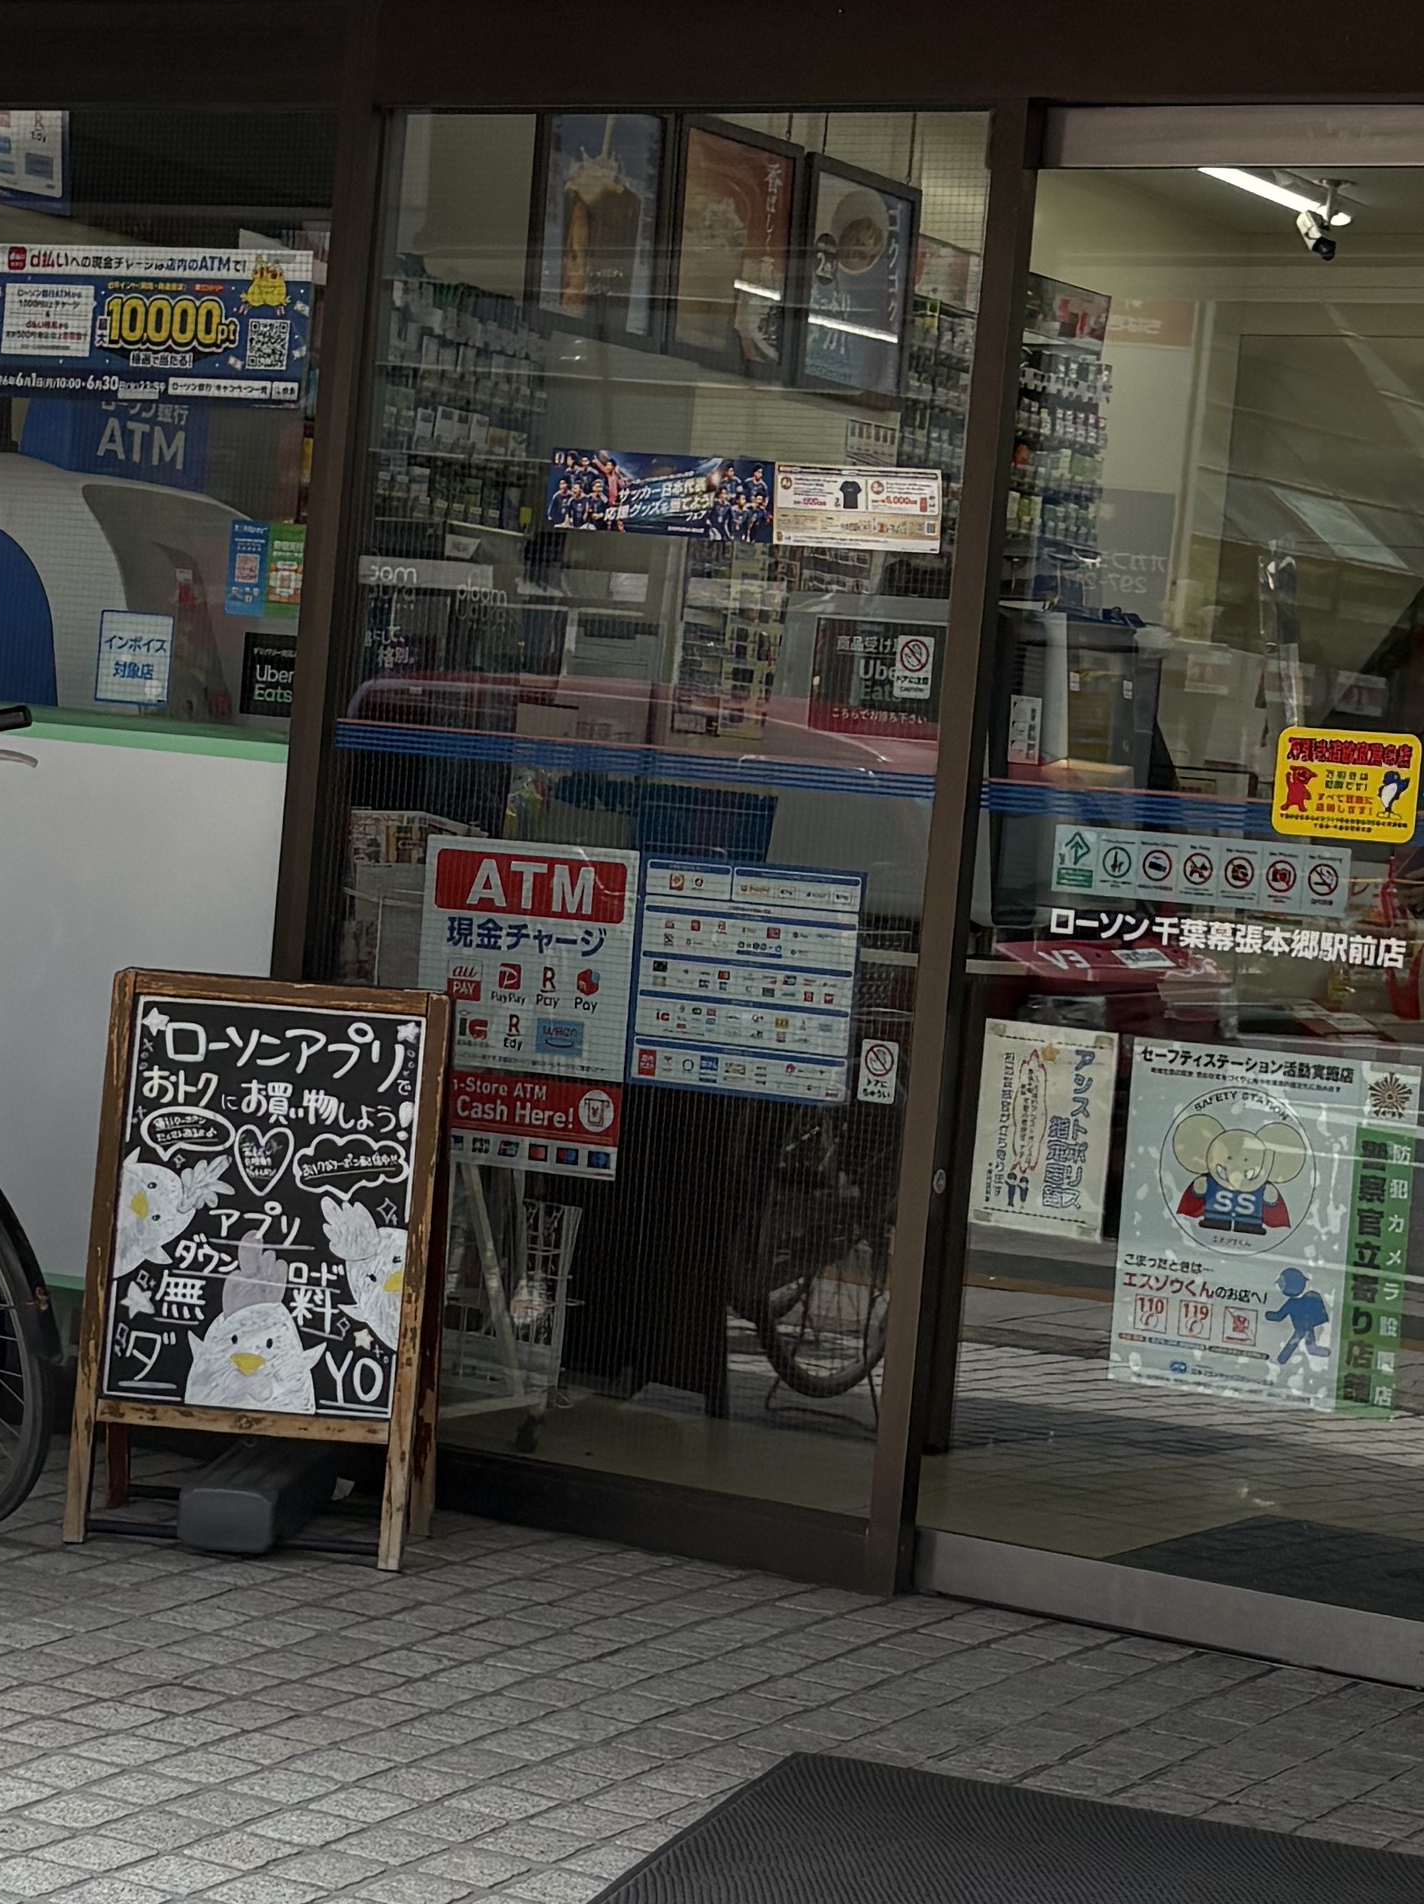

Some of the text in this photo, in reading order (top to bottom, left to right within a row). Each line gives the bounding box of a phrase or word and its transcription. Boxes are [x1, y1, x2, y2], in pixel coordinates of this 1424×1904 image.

[97, 416, 186, 470] ATM
[103, 632, 168, 656] インボイス
[837, 636, 898, 653] 商品受け
[256, 664, 295, 683] Uber
[254, 684, 293, 703] Eats
[466, 858, 596, 916] ATM
[447, 916, 607, 957] 現金チャージ
[452, 981, 476, 995] PAY
[536, 994, 560, 1009] Pay
[574, 997, 598, 1014] Pay
[513, 1082, 547, 1101] ATM
[1195, 1090, 1238, 1111] SAFETY
[456, 1096, 574, 1129] Cash Here!
[209, 1201, 303, 1245] アプリ
[1137, 1295, 1210, 1321] 110 119
[325, 1350, 385, 1404] YO
